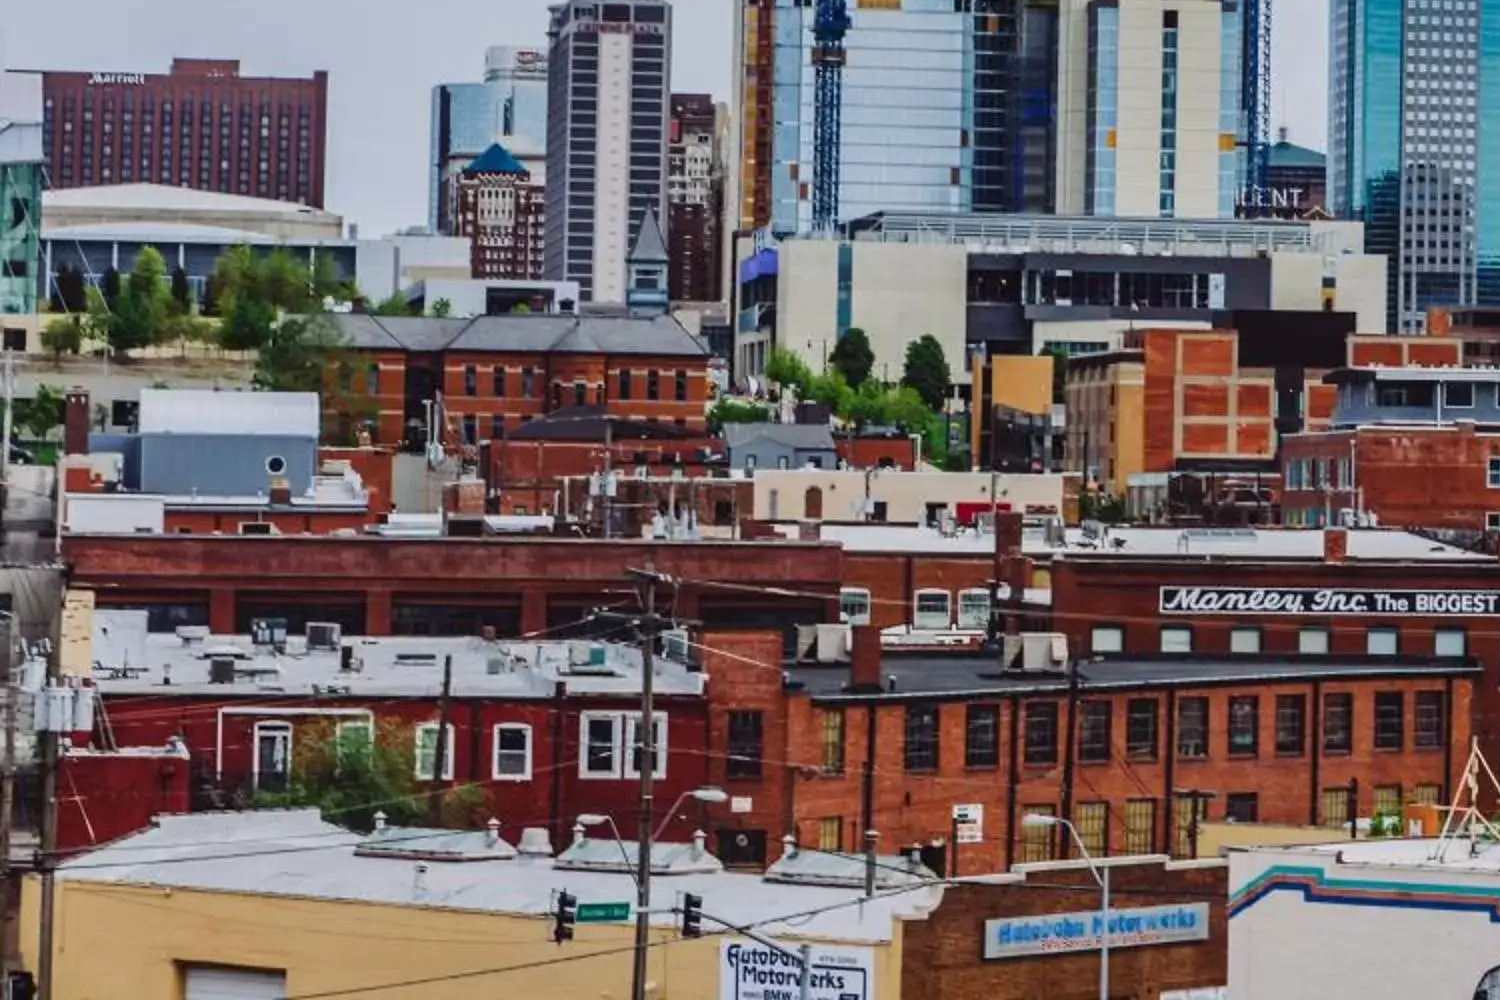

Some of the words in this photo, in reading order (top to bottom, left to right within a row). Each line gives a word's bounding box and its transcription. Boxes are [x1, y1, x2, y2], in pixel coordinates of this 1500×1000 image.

[88, 72, 144, 85] Marriott
[1311, 590, 1368, 612] Inc.
[1374, 594, 1408, 611] The
[1416, 594, 1498, 613] BIGGEST
[728, 944, 803, 967] Autobah
